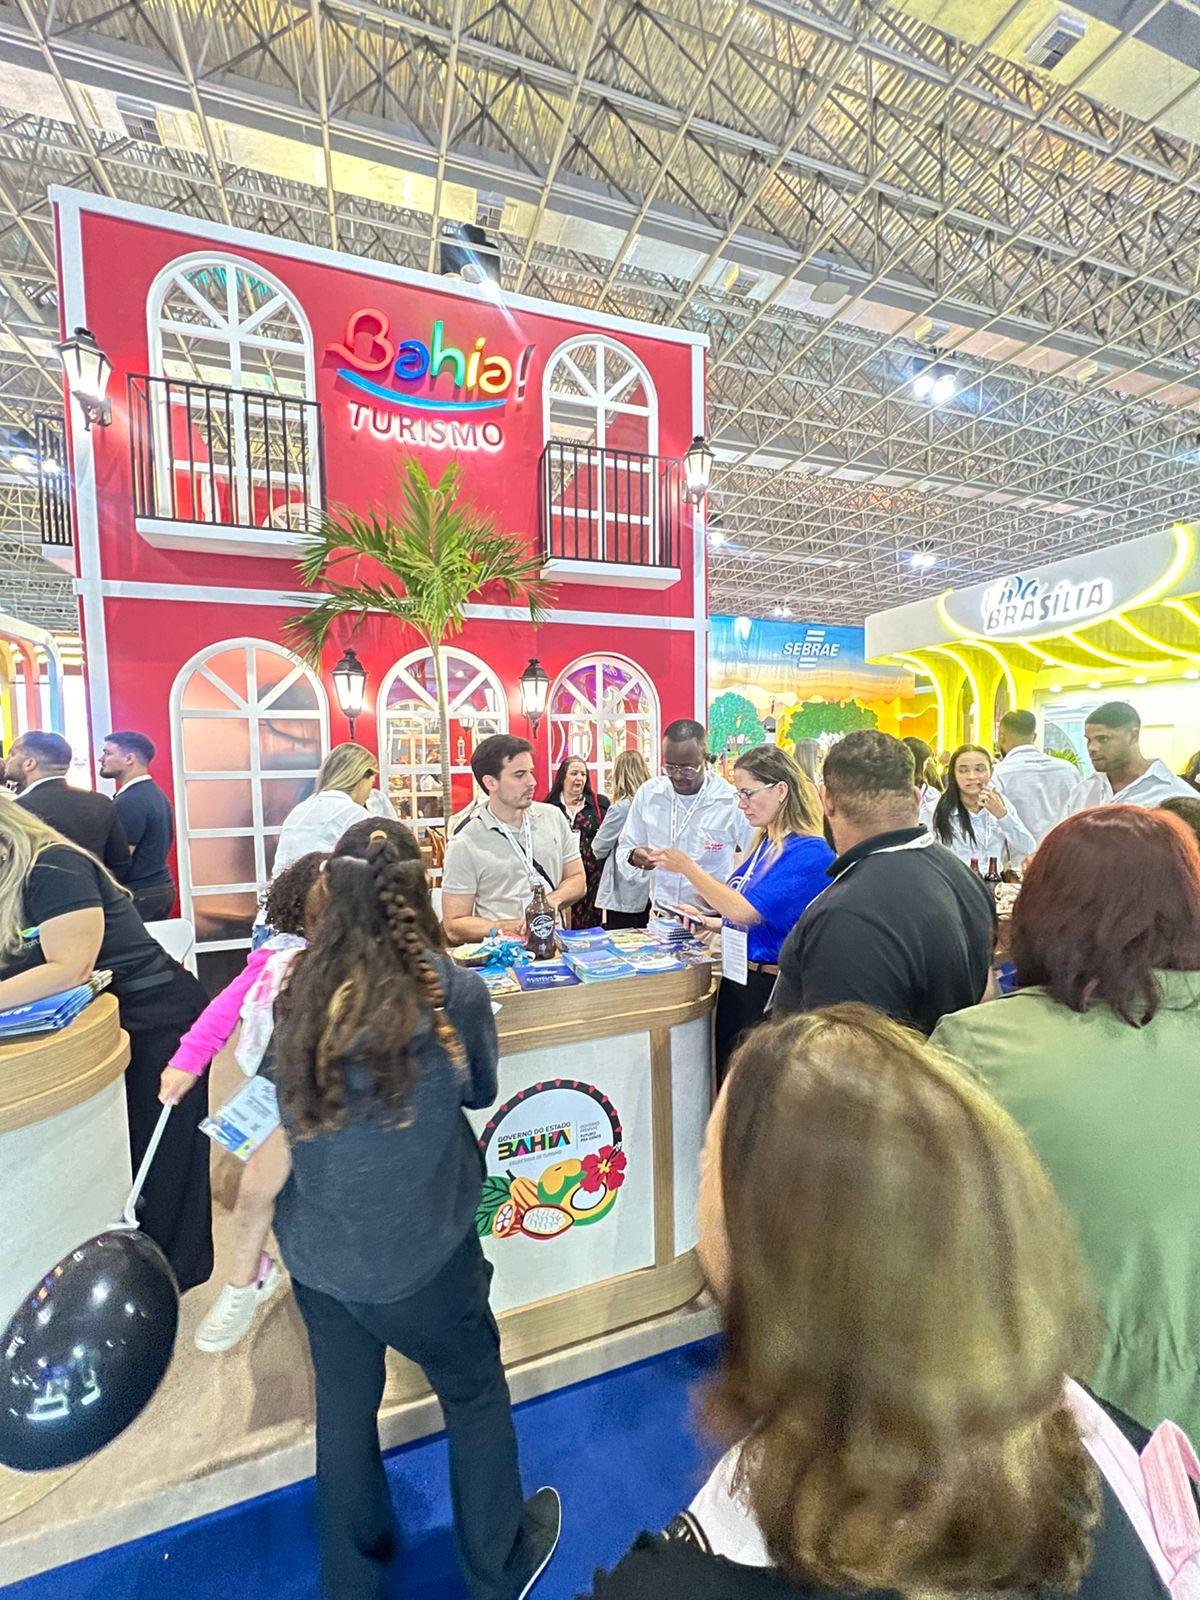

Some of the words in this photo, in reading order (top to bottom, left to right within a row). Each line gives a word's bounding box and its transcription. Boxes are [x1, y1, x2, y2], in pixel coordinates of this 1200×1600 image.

[325, 308, 536, 401] Bahia!
[349, 401, 503, 448] TURISMO
[986, 582, 1104, 630] BRASÍLIA
[783, 642, 840, 657] SEBRAE
[498, 1130, 532, 1143] GOVERNO
[546, 1121, 571, 1132] ESTADO
